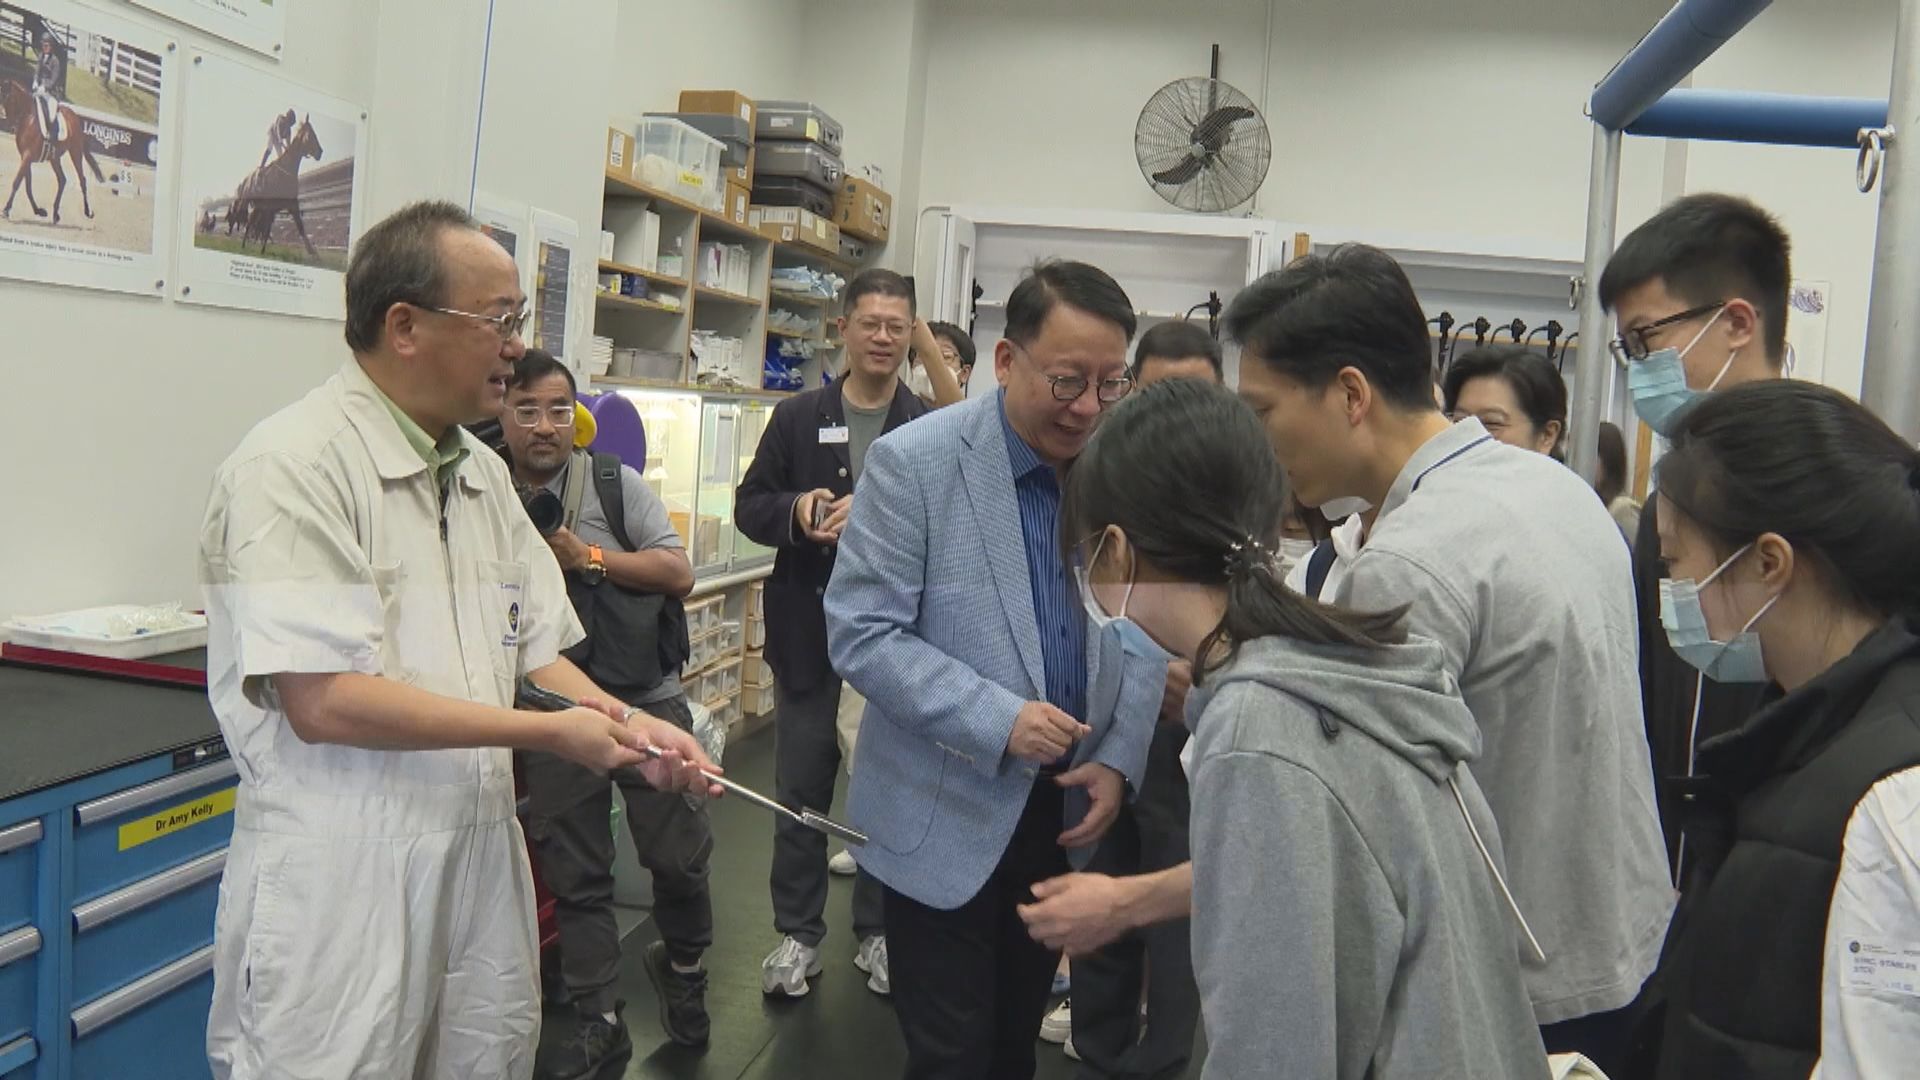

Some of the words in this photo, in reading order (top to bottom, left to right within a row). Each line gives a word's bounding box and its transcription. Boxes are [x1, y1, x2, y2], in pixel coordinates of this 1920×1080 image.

[83, 120, 132, 145] LONGINES
[155, 819, 167, 831] Dr
[168, 811, 189, 827] Amy
[191, 803, 214, 818] Kelly
